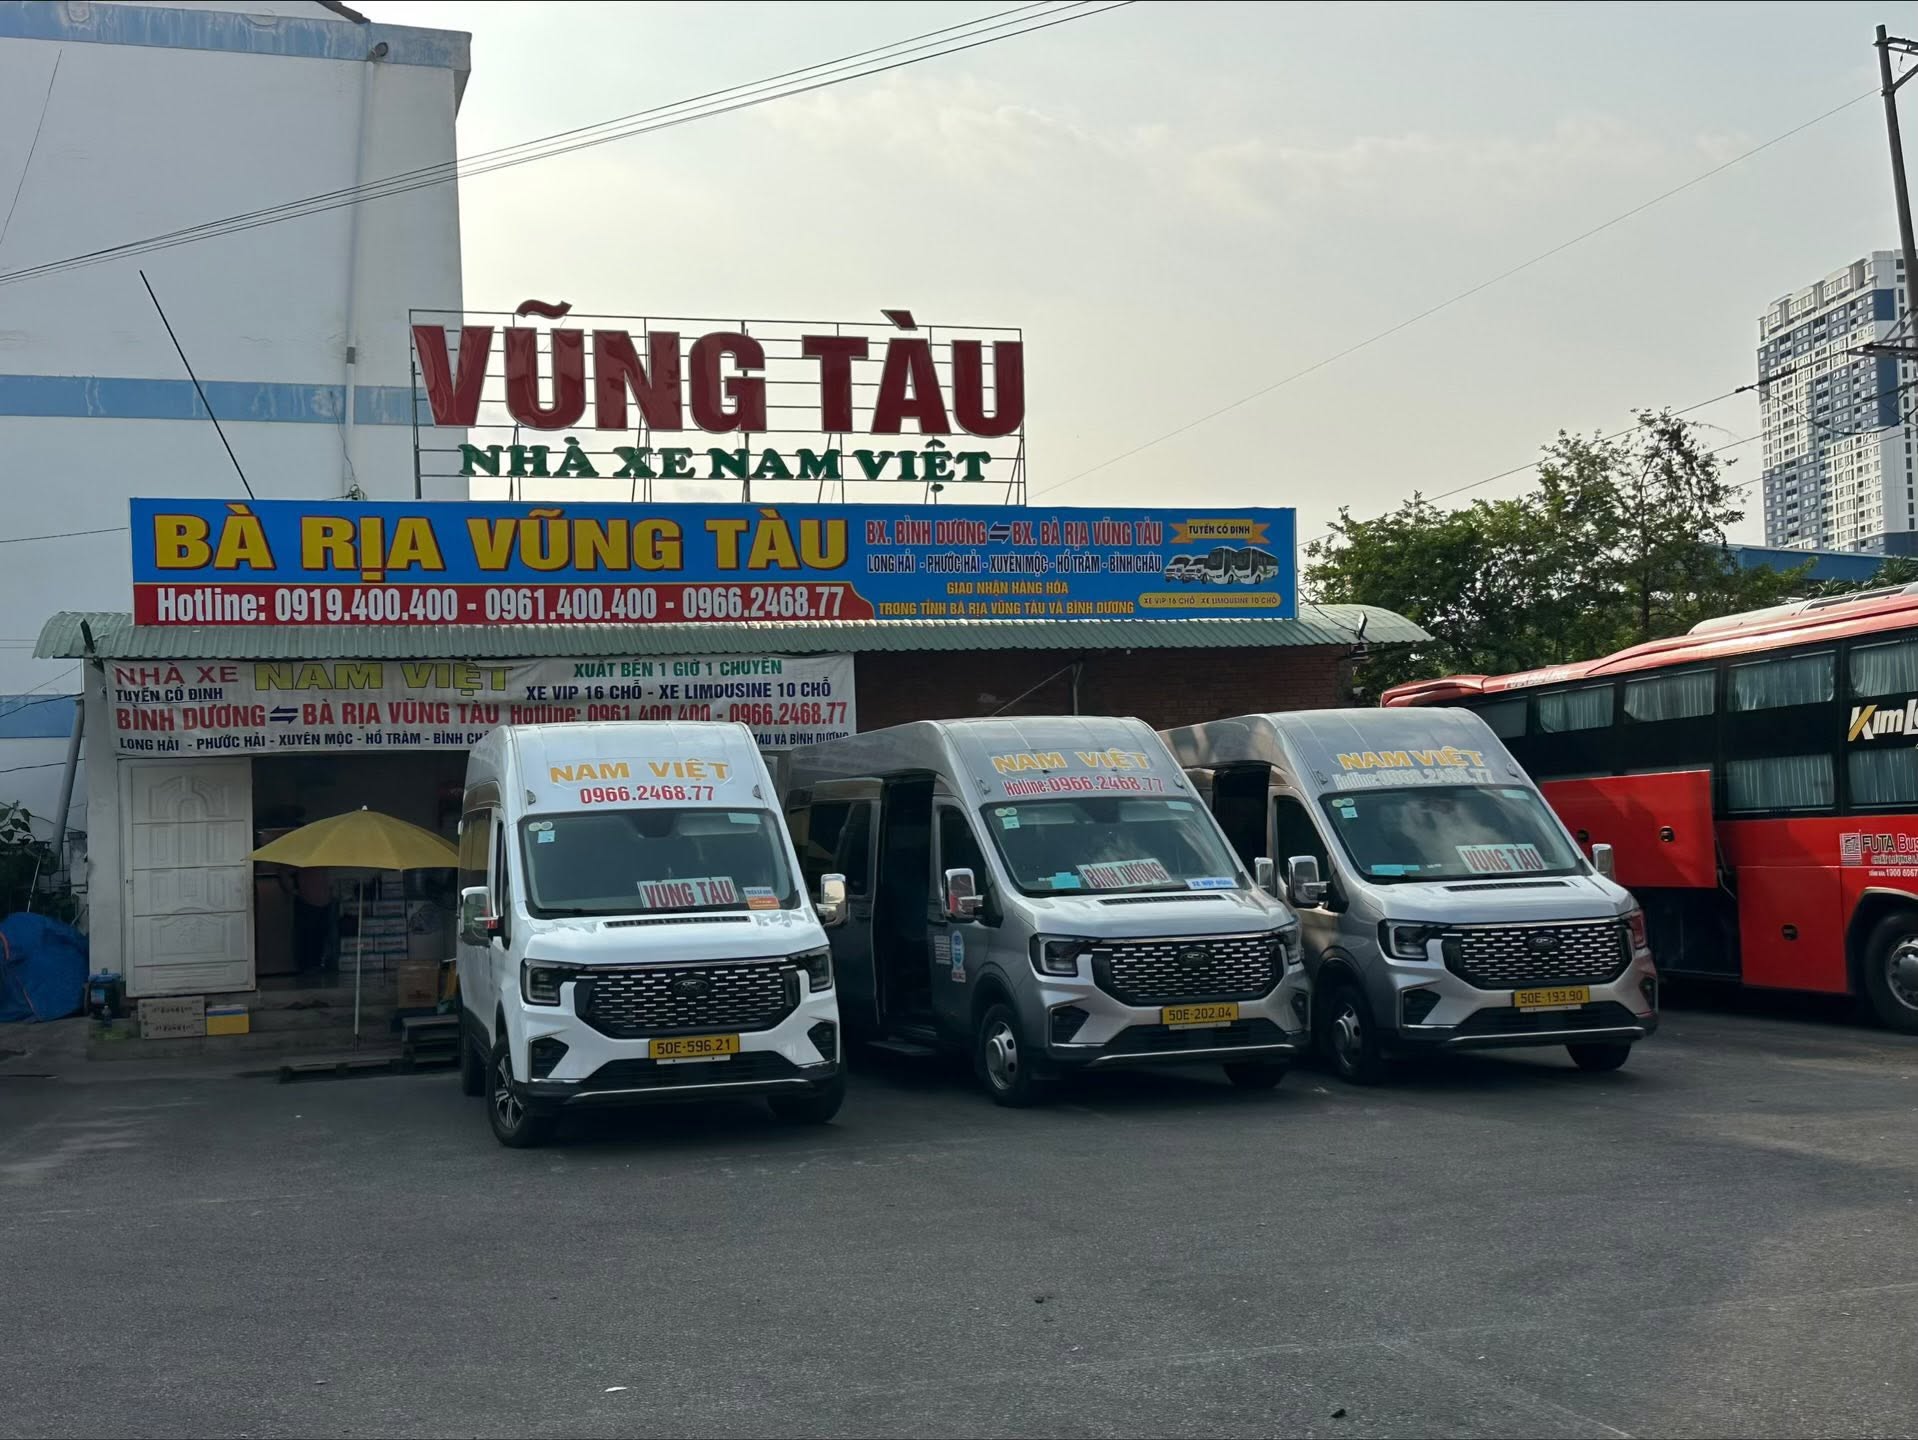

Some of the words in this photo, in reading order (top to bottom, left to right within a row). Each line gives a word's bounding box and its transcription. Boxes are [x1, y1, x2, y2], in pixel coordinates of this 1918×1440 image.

[411, 300, 767, 434] VŨNG
[801, 310, 1025, 438] TÀU
[458, 437, 599, 477] NHÀ
[614, 447, 696, 479] XE
[708, 448, 841, 481] NAM
[852, 440, 992, 492] VIỆT
[154, 503, 276, 571] BÀ
[301, 516, 446, 582] RỊA
[466, 508, 684, 571] VŨNG
[705, 508, 848, 570] TÀU
[866, 519, 892, 545] BX.
[895, 515, 932, 545] BÌNH
[935, 518, 987, 545] DƯƠNG
[1012, 521, 1037, 545] BX.
[1040, 516, 1061, 545] BÀ
[1063, 520, 1089, 550] RỊA
[1092, 516, 1131, 545] VŨNG
[1135, 516, 1163, 545] TÀU
[867, 555, 895, 573] LONG
[896, 548, 916, 573] HẢI
[926, 551, 961, 573] PHƯỚC
[962, 549, 981, 573] HẢI
[989, 551, 1024, 573] XUYÊN
[1025, 551, 1050, 577] MỘC
[1071, 551, 1101, 573] TRÀM
[1109, 551, 1134, 573] BÌNH
[1135, 551, 1162, 573] CHÂU
[947, 582, 973, 594] GIAO
[976, 580, 1008, 596] NHẬN
[1011, 580, 1042, 594] HÀNG
[1046, 580, 1068, 594] HÓA
[157, 588, 266, 621] Hotline:
[275, 588, 458, 621] 0919.400.400
[485, 587, 657, 620] 0961.400.400
[682, 586, 844, 618] 0966.2468.77
[879, 602, 917, 615] TRONG
[1096, 600, 1134, 614] DƯƠNG
[115, 662, 185, 686] NHÀ
[197, 665, 239, 683] XE
[253, 663, 384, 690] NAM
[621, 657, 653, 677] BẾN
[660, 662, 666, 677] 1
[673, 658, 700, 677] GIỜ
[706, 662, 712, 676] 1
[719, 657, 782, 675] CHUYẾN
[116, 687, 160, 702] TUYẾN
[165, 684, 184, 702] CỐ
[526, 686, 547, 700] XE
[552, 686, 579, 700] VIP
[585, 685, 605, 700] 16
[609, 679, 642, 700] CHỖ
[659, 684, 679, 699] XE
[685, 682, 771, 700] LIMOUSINE
[777, 682, 796, 698] 10
[801, 676, 831, 698] CHỖ
[116, 705, 175, 731] BÌNH
[182, 704, 265, 731] DƯƠNG
[303, 699, 334, 725] BÀ
[342, 702, 381, 729] RỊA
[388, 698, 449, 725] VŨNG
[457, 700, 500, 724] TÀU
[510, 703, 581, 724] Hotline:
[730, 702, 847, 726] 0966.2468.77
[120, 737, 153, 750] LONG
[157, 736, 179, 751] HẢI
[197, 734, 240, 749] PHƯỚC
[244, 732, 265, 748] HẢI
[279, 731, 320, 746] XUYÊN
[324, 731, 353, 747] MỘC
[386, 730, 421, 744] TRÀM
[433, 731, 463, 744] BÌNH
[790, 731, 813, 745] BÌNH
[550, 762, 630, 783] NAM
[648, 758, 728, 781] VIỆT
[991, 752, 1068, 773] NAM
[1075, 747, 1150, 771] VIỆT
[1336, 751, 1414, 770] NAM
[580, 785, 714, 804] 0966.2468.77
[1862, 834, 1896, 853] FUTA
[1508, 843, 1544, 871] TÀU
[1083, 864, 1123, 888] BÌNH
[1117, 861, 1168, 885] DƯƠNG
[643, 879, 696, 908] VŨNG
[696, 876, 736, 904] TÀU
[1520, 990, 1583, 1004] 50E-193.90
[1169, 1007, 1232, 1021] 50E-202.04
[657, 1038, 730, 1055] 50E-596.21
